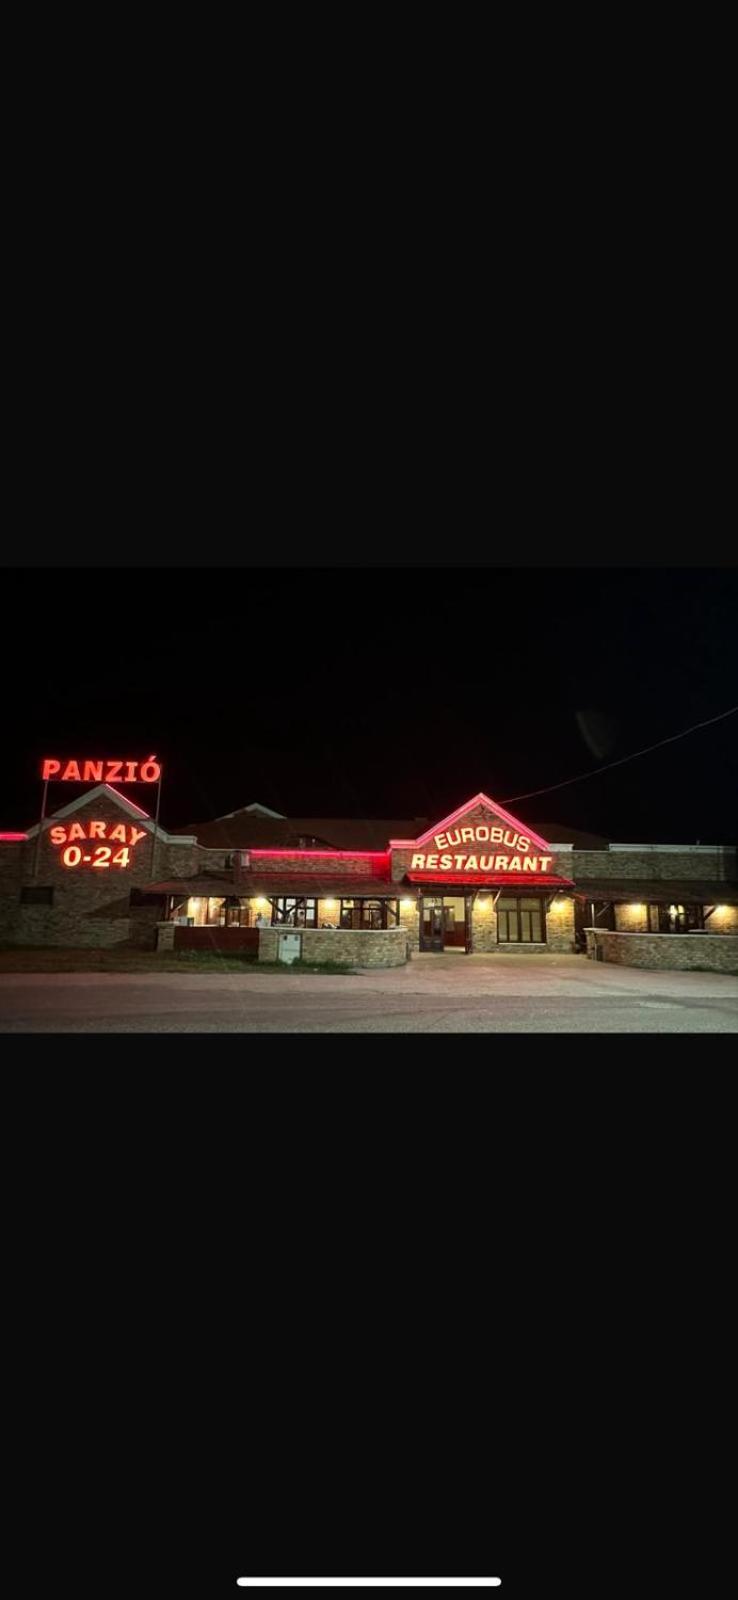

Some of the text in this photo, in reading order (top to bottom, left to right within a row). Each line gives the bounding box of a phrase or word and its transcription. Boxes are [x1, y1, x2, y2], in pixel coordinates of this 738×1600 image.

[42, 755, 161, 782] PANZIÓ
[50, 821, 147, 846] SARAY
[434, 826, 531, 852] EUROBUS
[63, 846, 130, 867] 0-24
[411, 853, 552, 872] RESTAURANT
